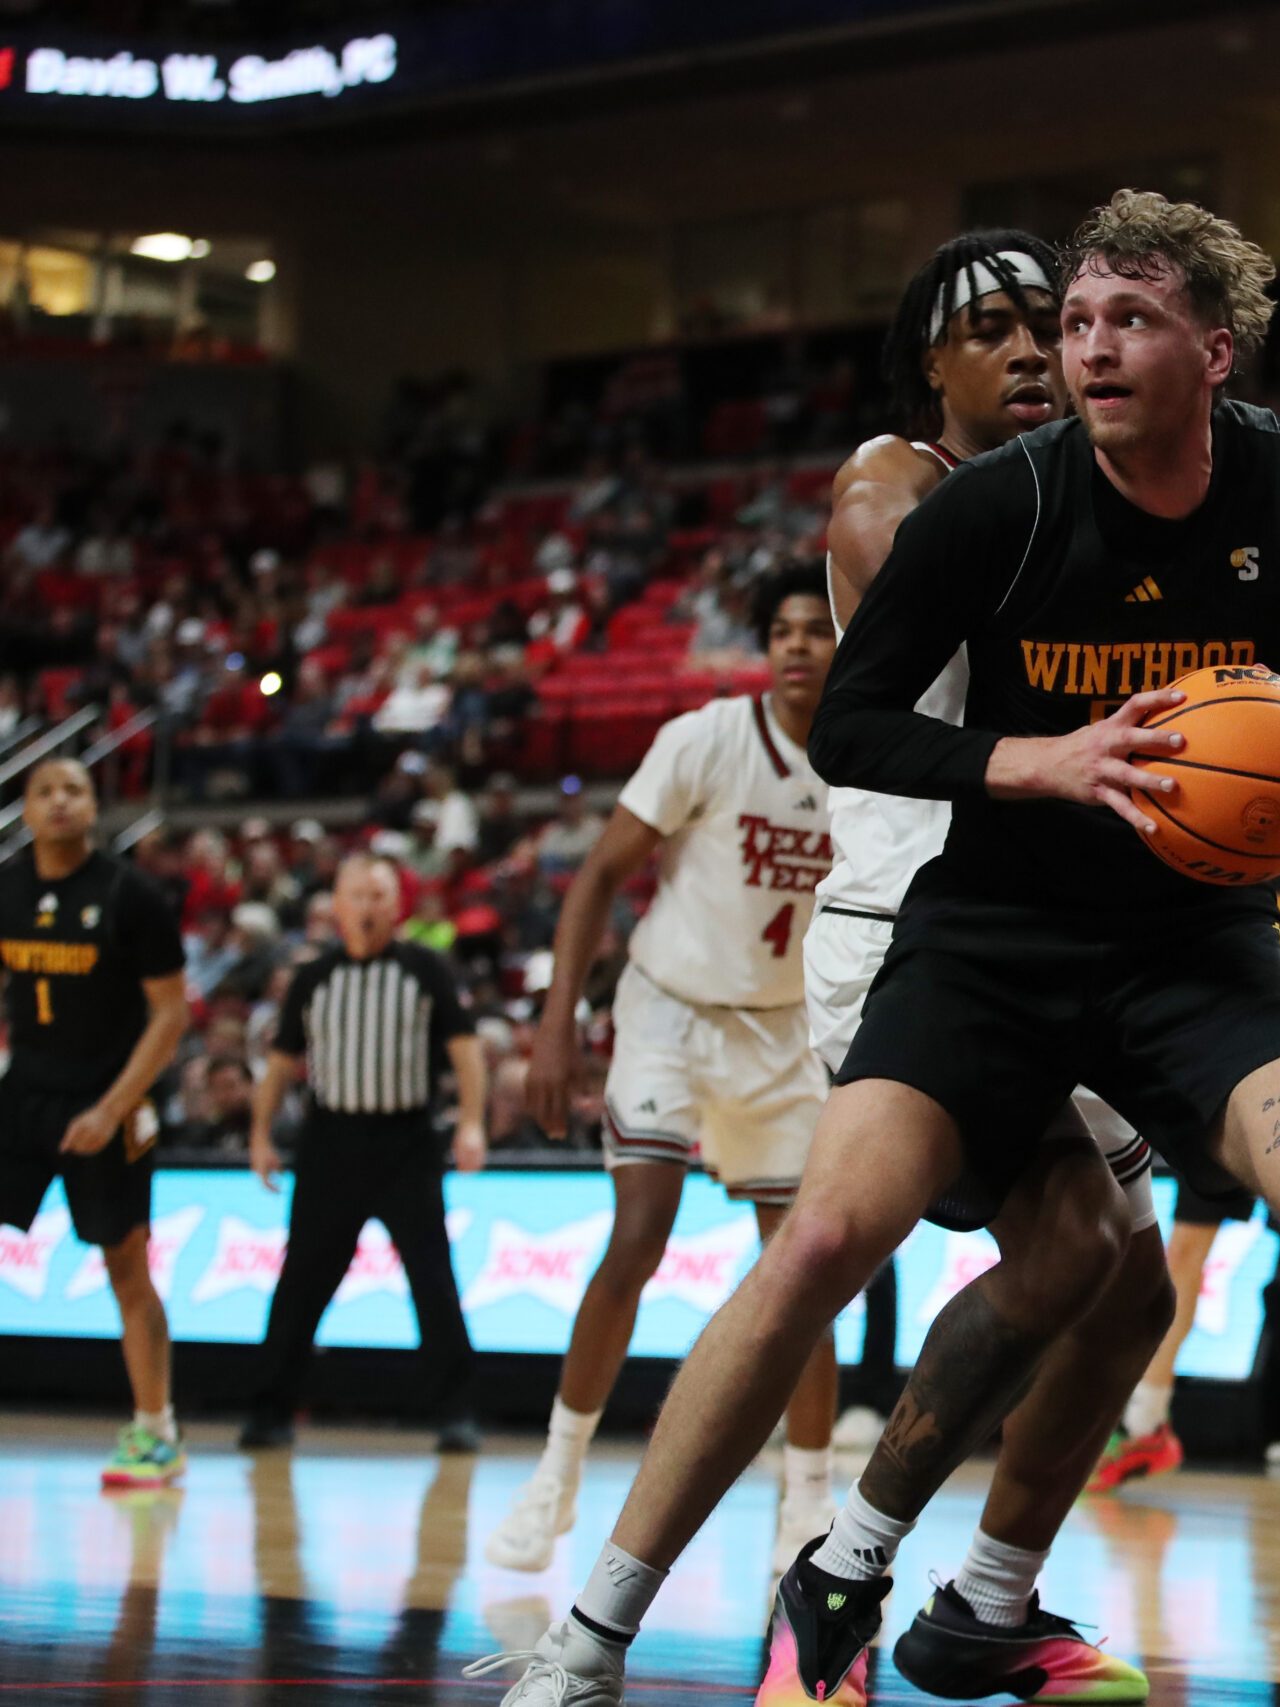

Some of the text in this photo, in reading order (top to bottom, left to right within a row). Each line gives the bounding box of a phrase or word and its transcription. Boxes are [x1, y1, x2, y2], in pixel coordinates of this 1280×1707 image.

[26, 48, 158, 99] Davis
[738, 814, 834, 866] TEXA
[762, 902, 795, 958] 4
[36, 977, 53, 1026] 1
